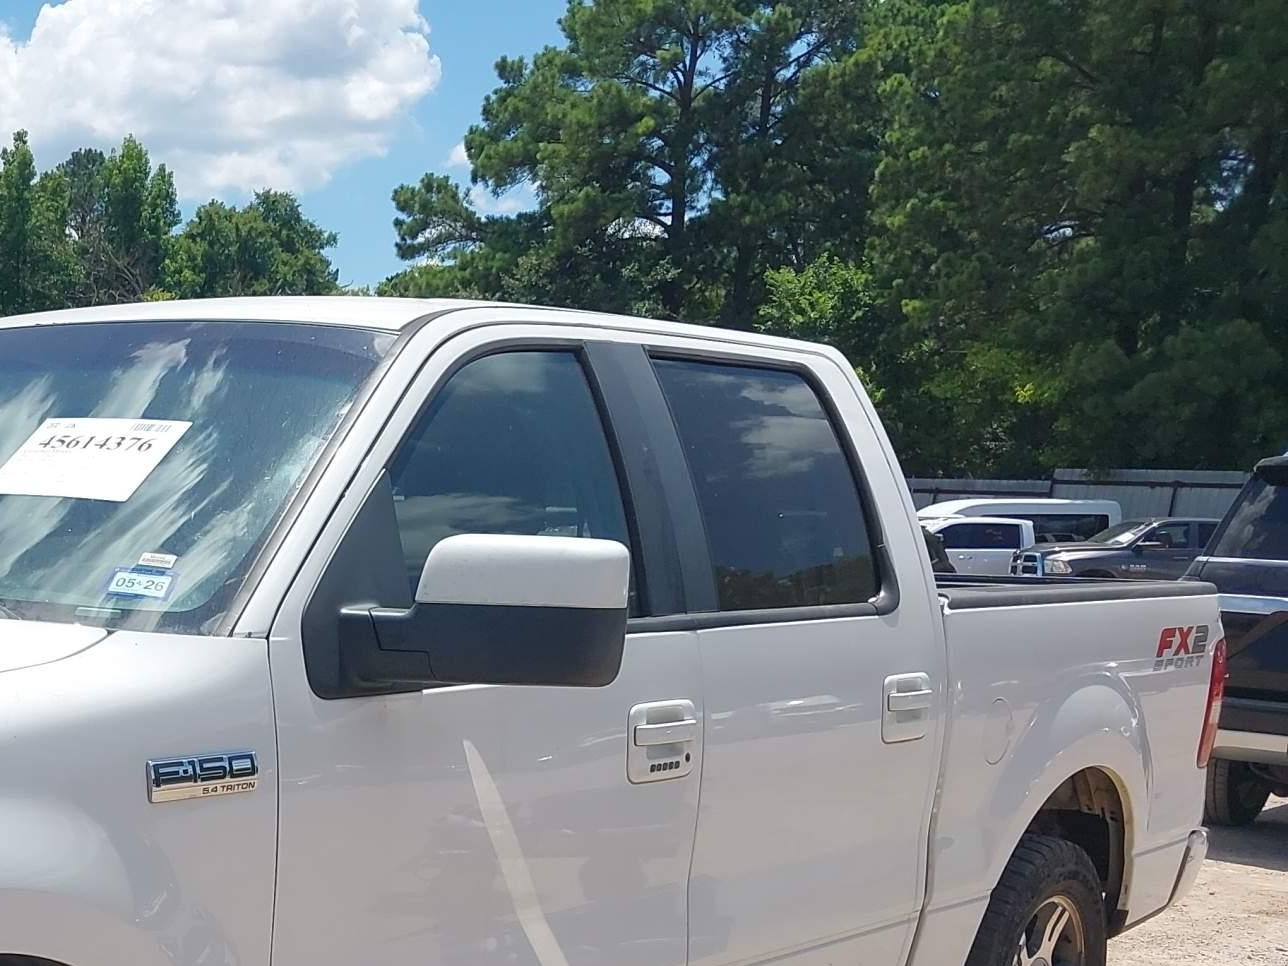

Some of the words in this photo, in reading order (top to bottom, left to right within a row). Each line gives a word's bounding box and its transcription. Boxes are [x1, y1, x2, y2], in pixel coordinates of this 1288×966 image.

[39, 435, 158, 451] 45614376
[115, 577, 137, 588] 05
[143, 579, 166, 592] 26
[1156, 624, 1209, 658] FX2
[1152, 655, 1204, 672] SPORT
[151, 752, 256, 788] F-150
[221, 782, 256, 793] TRITON
